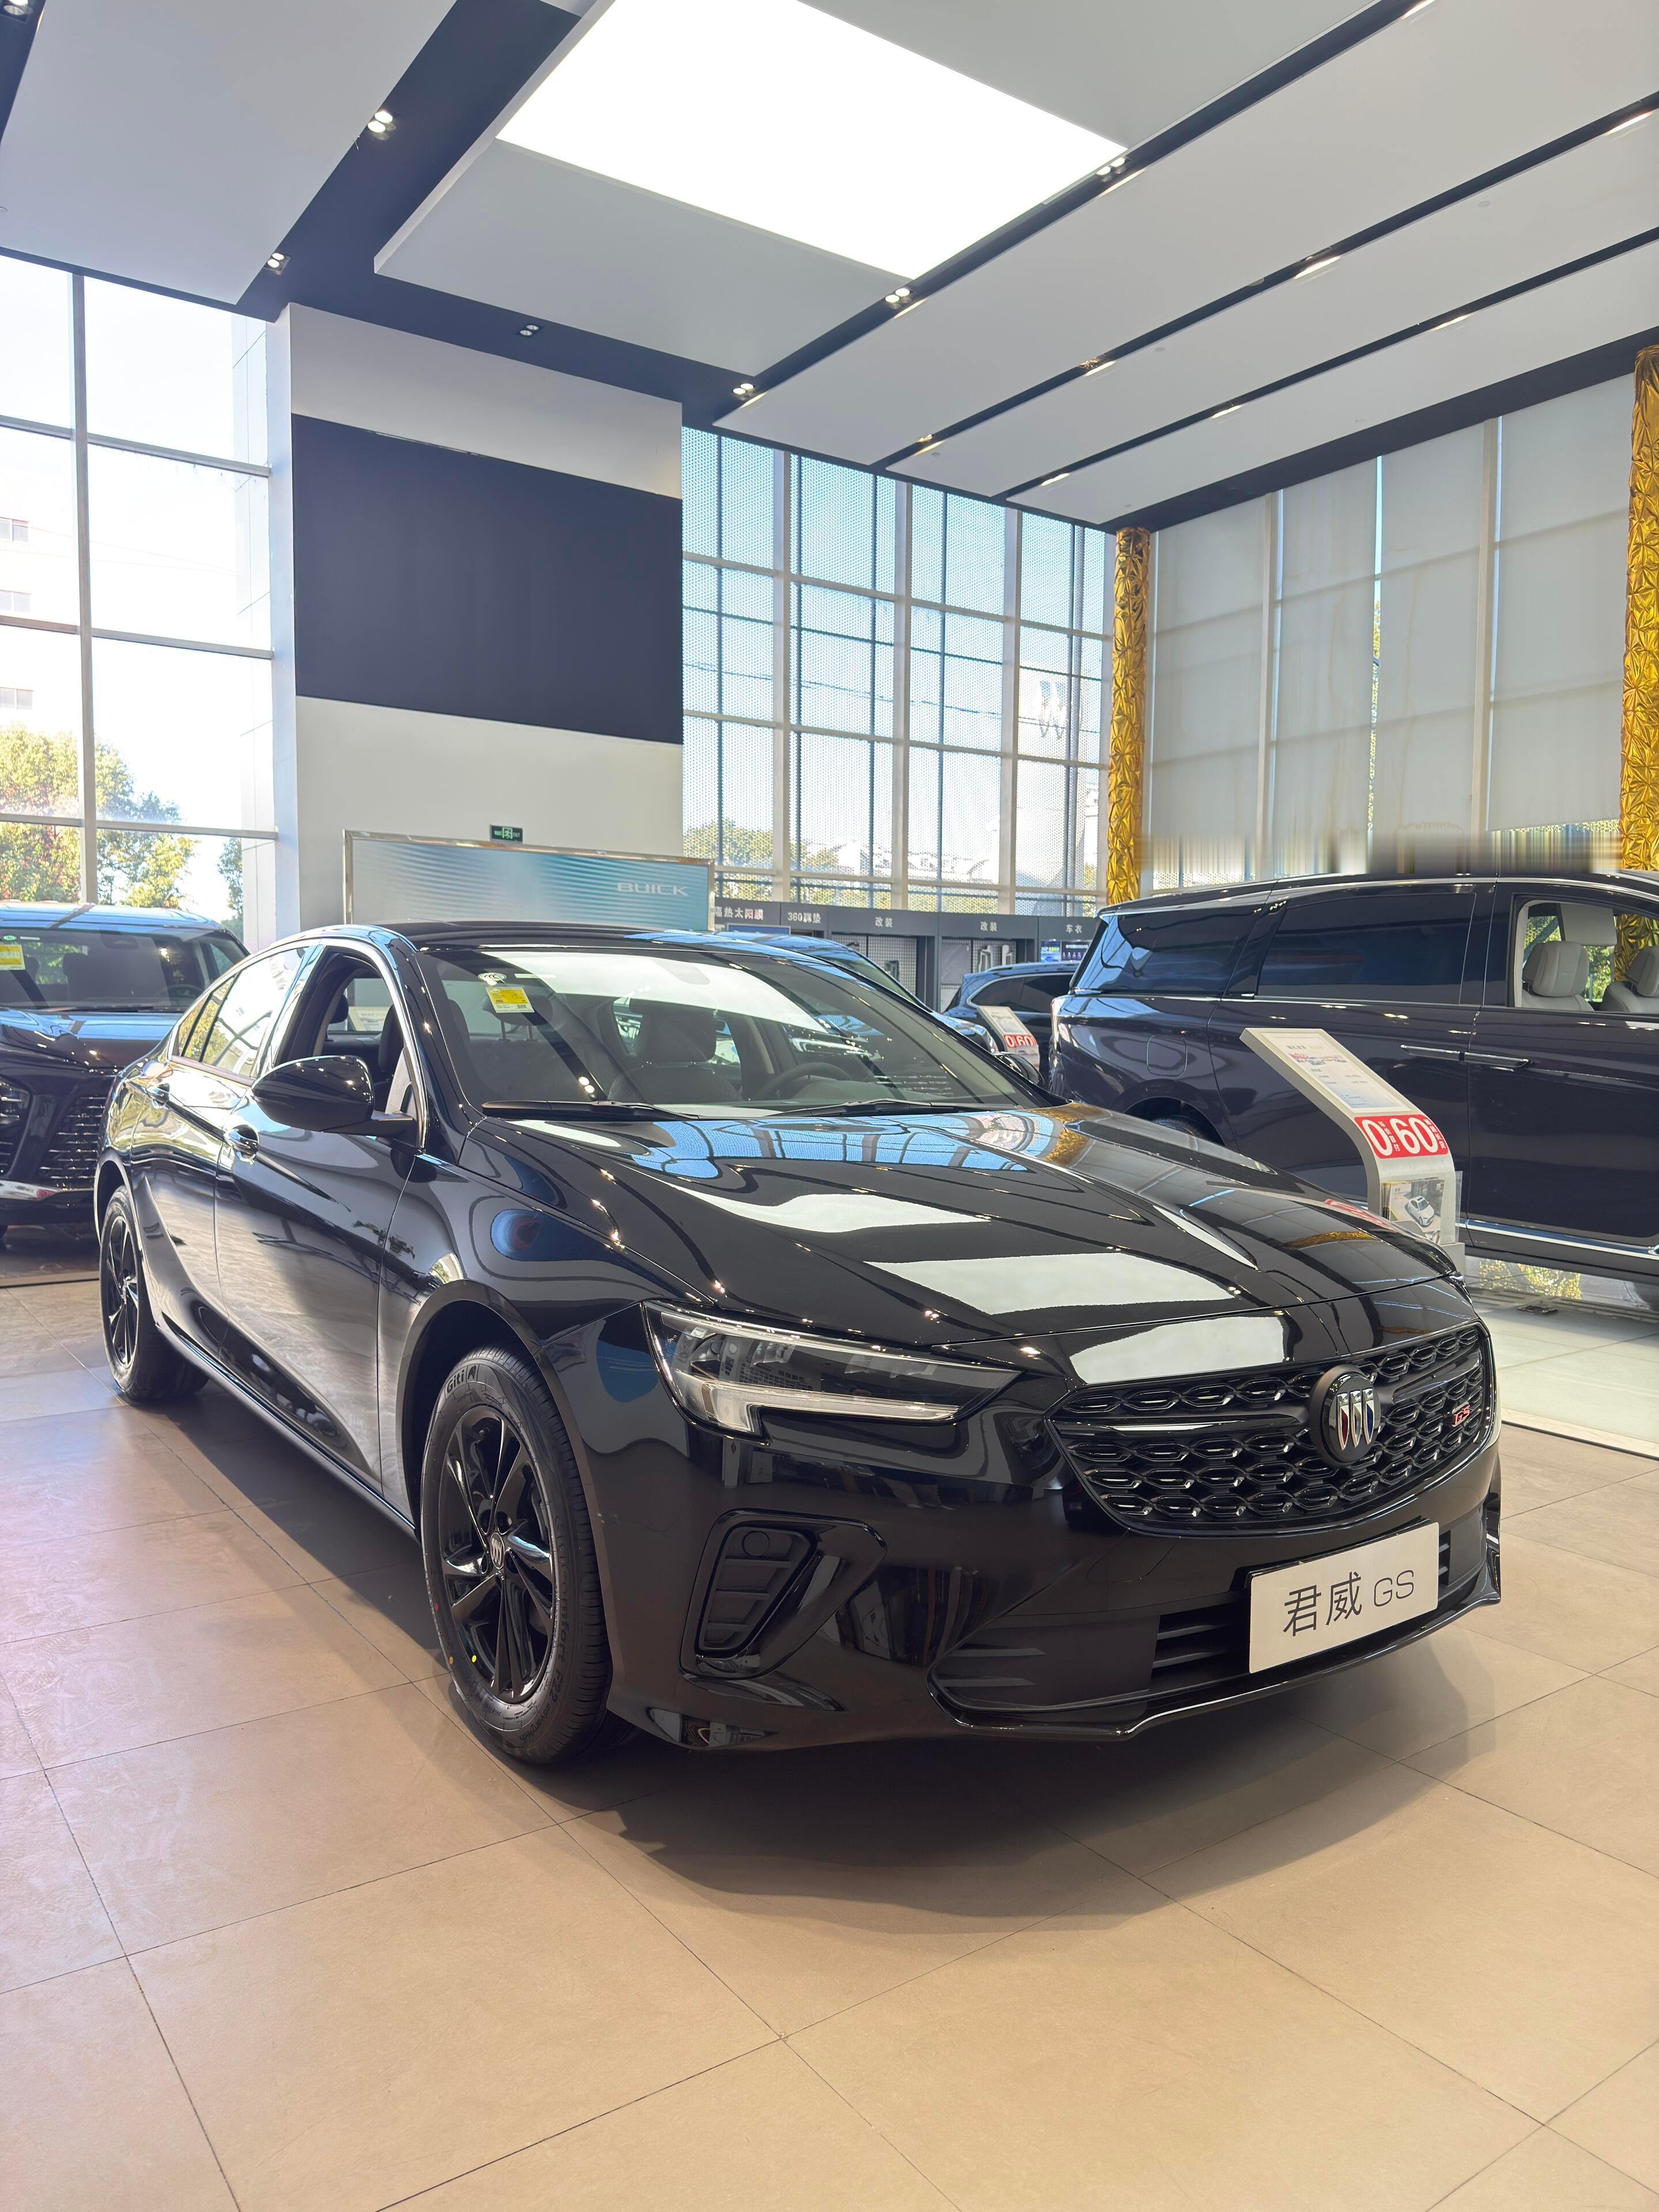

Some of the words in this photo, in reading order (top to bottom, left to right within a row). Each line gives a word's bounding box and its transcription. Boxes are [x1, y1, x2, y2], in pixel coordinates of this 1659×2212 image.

[618, 882, 689, 896] BUICK
[875, 916, 893, 928] 改装
[980, 921, 997, 932] 改装
[1066, 924, 1082, 934] 车衣
[1362, 1119, 1392, 1156] 0
[1389, 1118, 1438, 1154] 60
[446, 1369, 464, 1393] Giti
[1454, 1404, 1471, 1427] GS
[1283, 1571, 1363, 1637] 君威
[1373, 1570, 1414, 1607] GS
